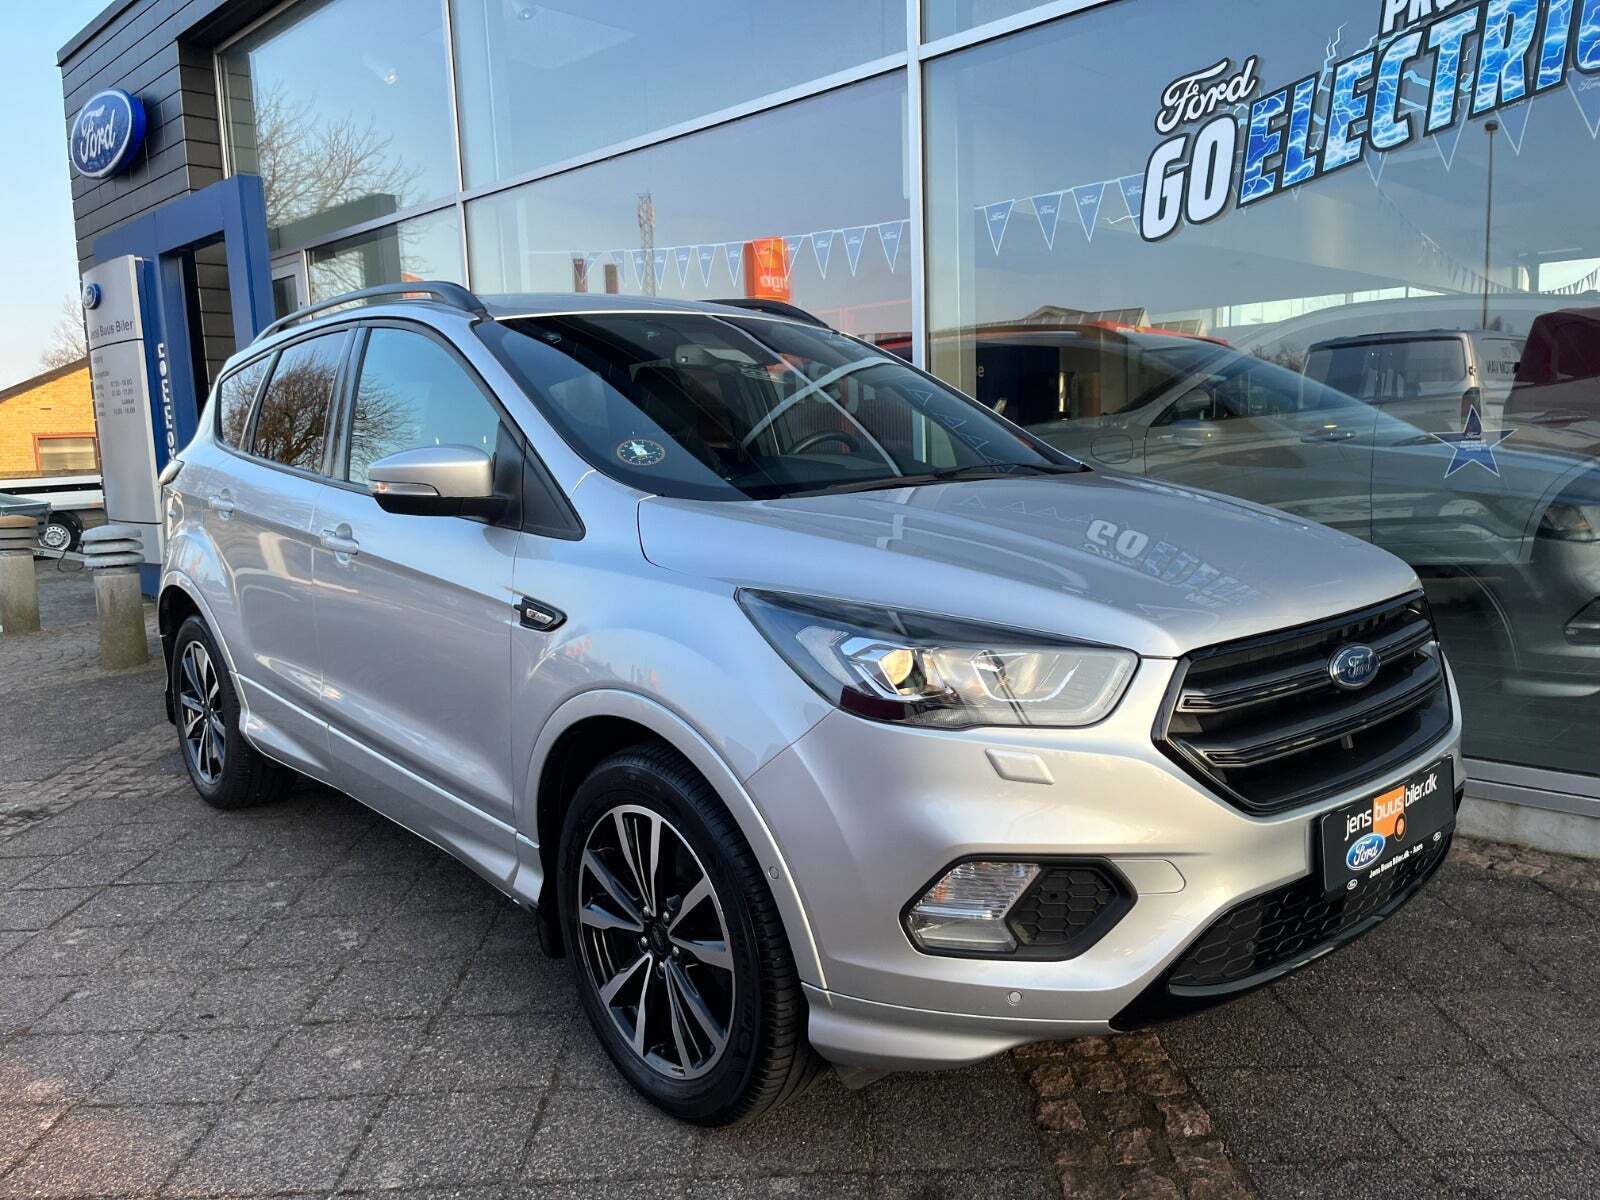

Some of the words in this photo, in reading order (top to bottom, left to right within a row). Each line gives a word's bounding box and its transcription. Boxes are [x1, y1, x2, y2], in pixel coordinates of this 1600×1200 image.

[1155, 55, 1259, 134] Ford
[80, 104, 116, 164] Ford
[115, 319, 133, 334] Biler
